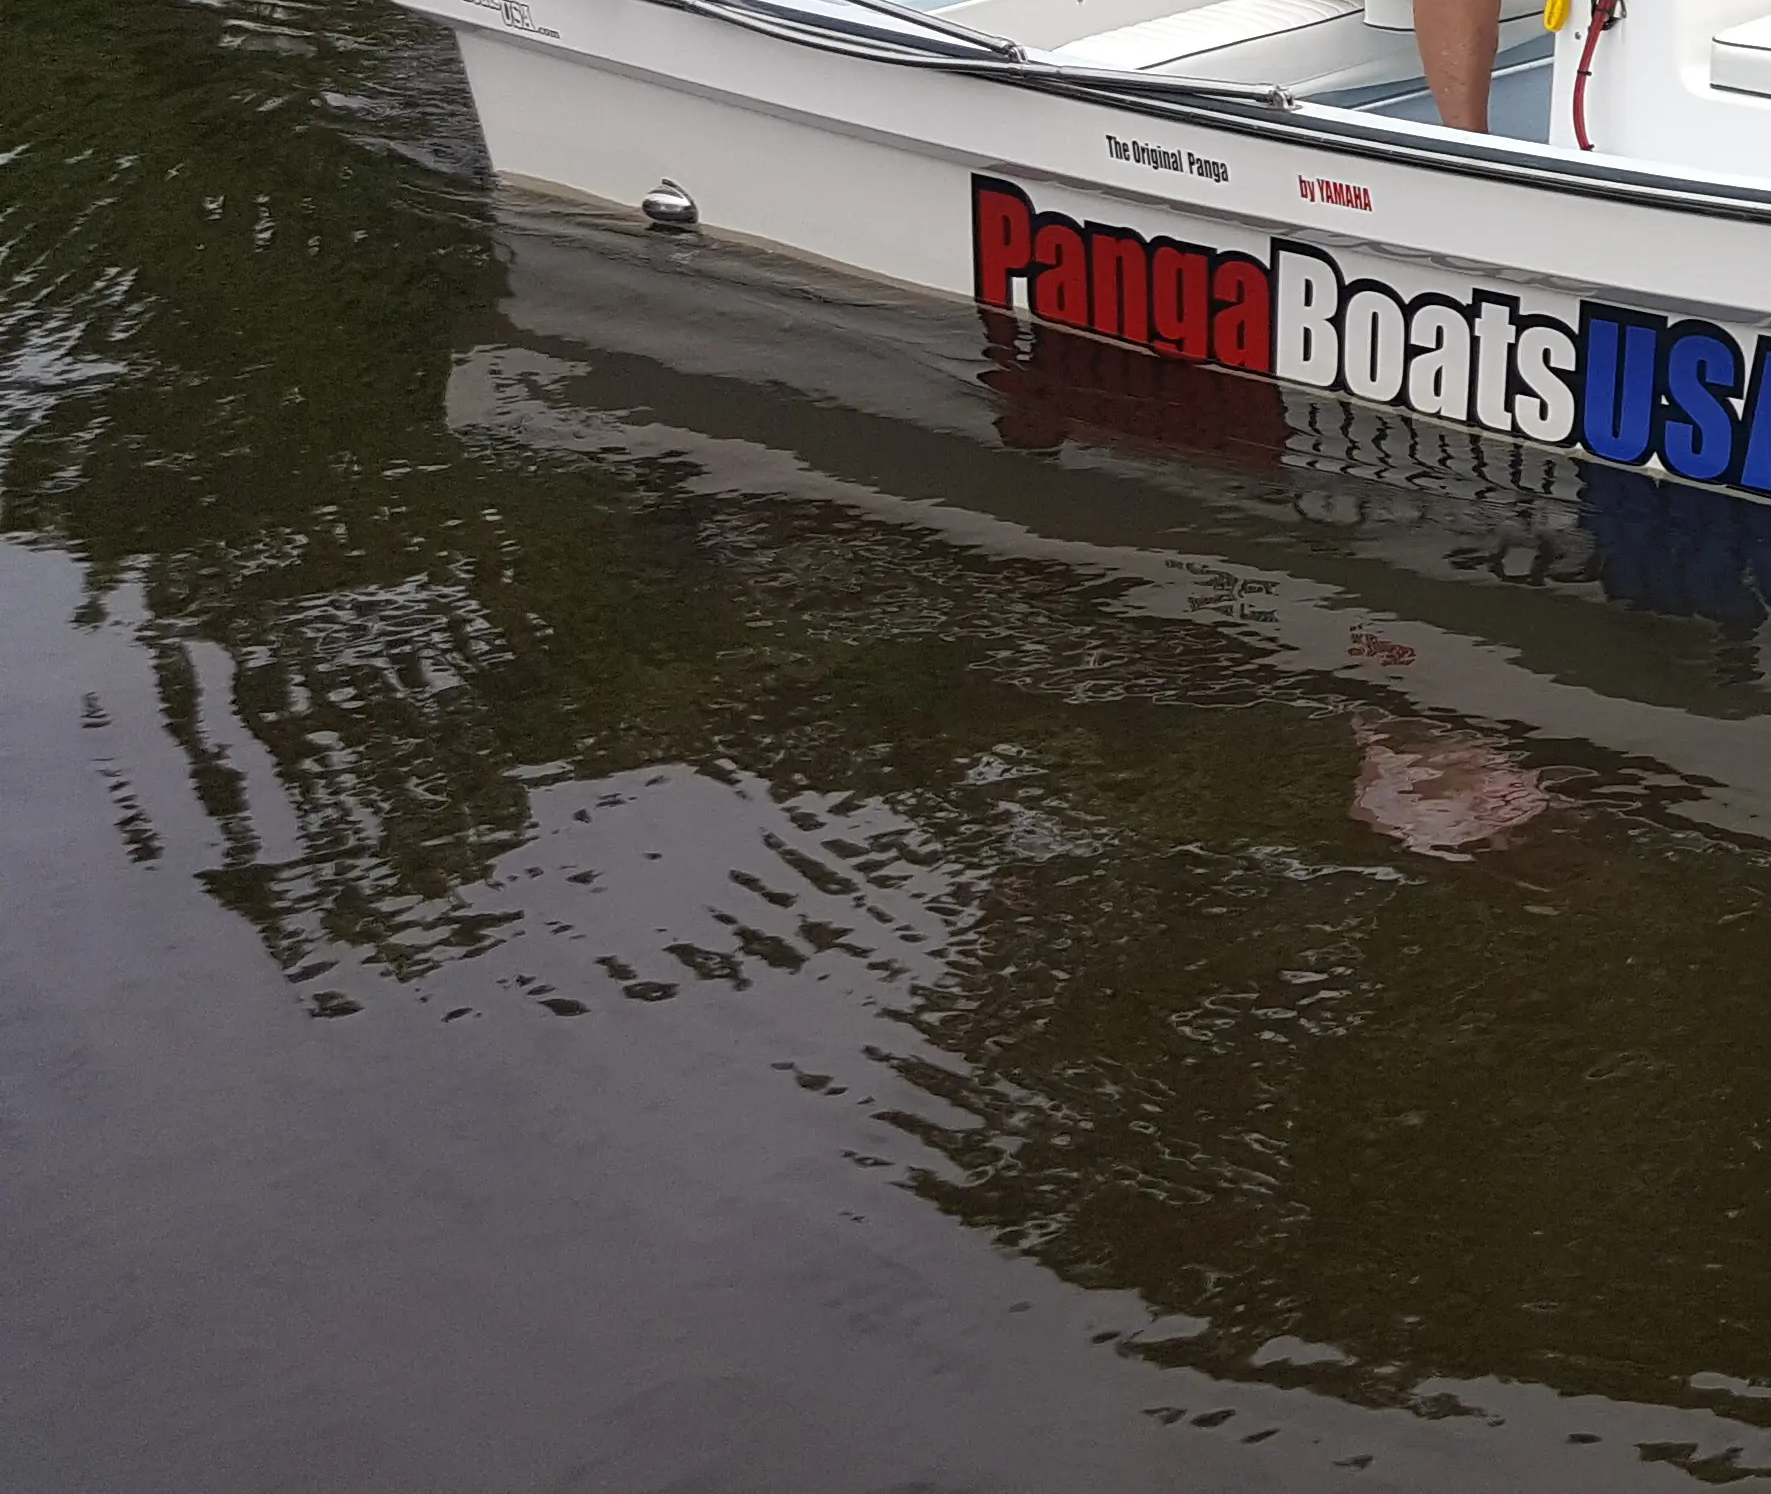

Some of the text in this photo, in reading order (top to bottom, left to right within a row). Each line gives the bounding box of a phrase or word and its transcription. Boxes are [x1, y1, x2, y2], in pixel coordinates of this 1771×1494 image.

[1106, 134, 1230, 184] The Original Panga
[1298, 174, 1373, 212] by YAMAHA
